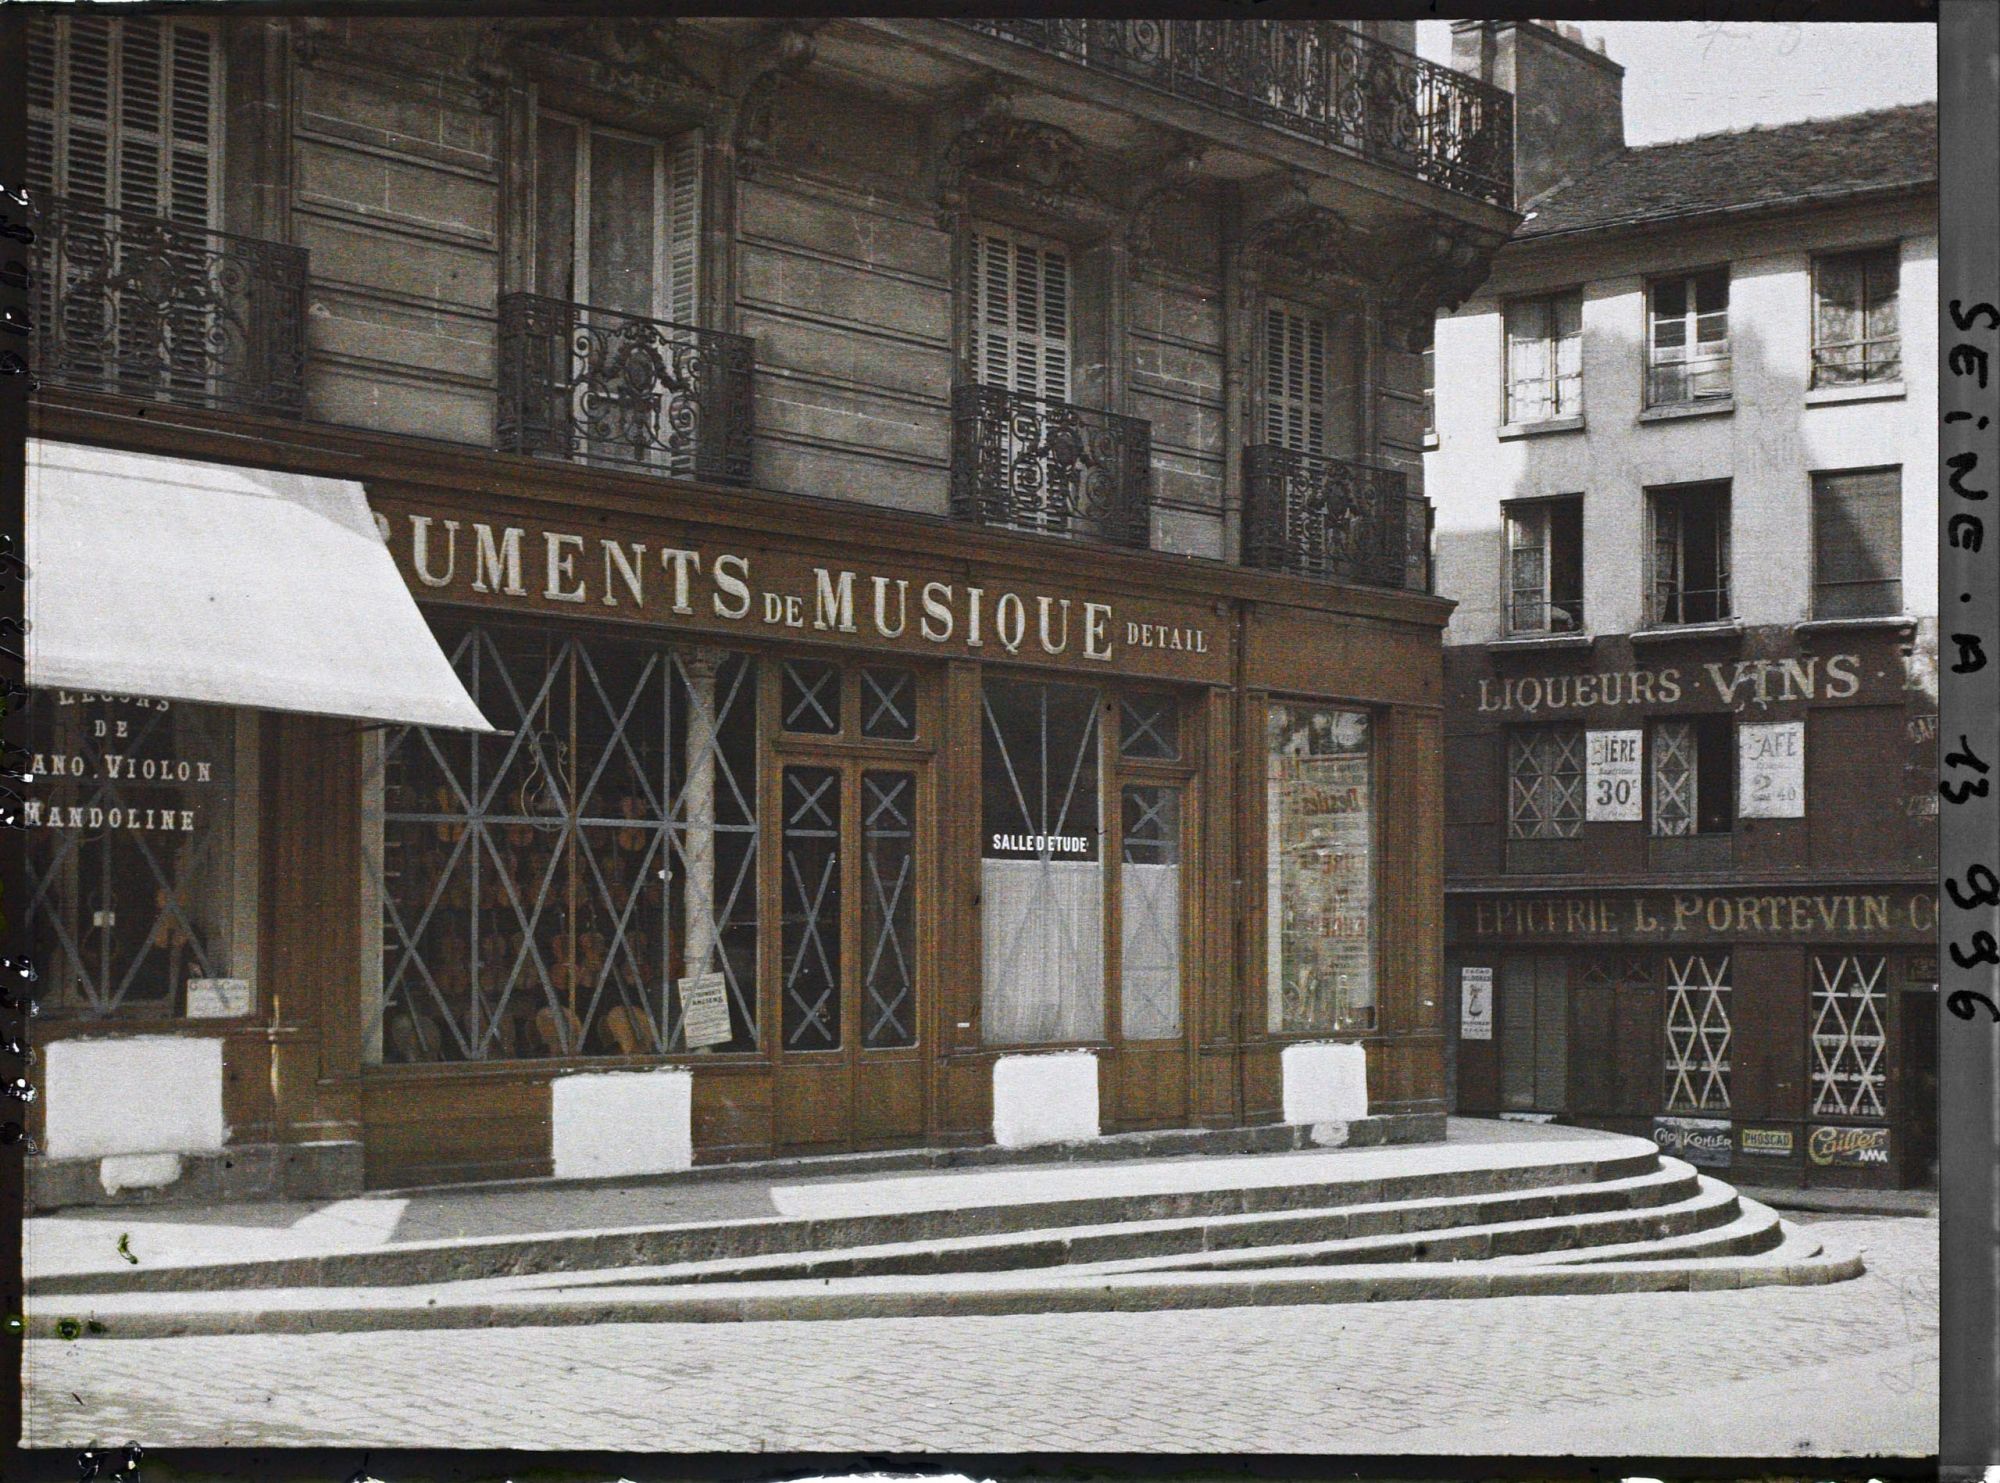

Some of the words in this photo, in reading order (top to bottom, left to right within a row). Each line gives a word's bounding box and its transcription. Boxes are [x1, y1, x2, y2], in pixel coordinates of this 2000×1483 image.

[762, 592, 804, 628] DE
[813, 568, 1113, 662] MUSIQUE
[1127, 622, 1208, 653] DETAIL
[1478, 669, 1681, 713] LIQUEURS
[1704, 654, 1861, 704] VINS
[94, 719, 128, 738] DE
[104, 754, 212, 782] VIOLON
[24, 801, 195, 831] MANDOLINE
[992, 833, 1034, 851] SALLE
[1673, 894, 1890, 933] PORTEVIN
